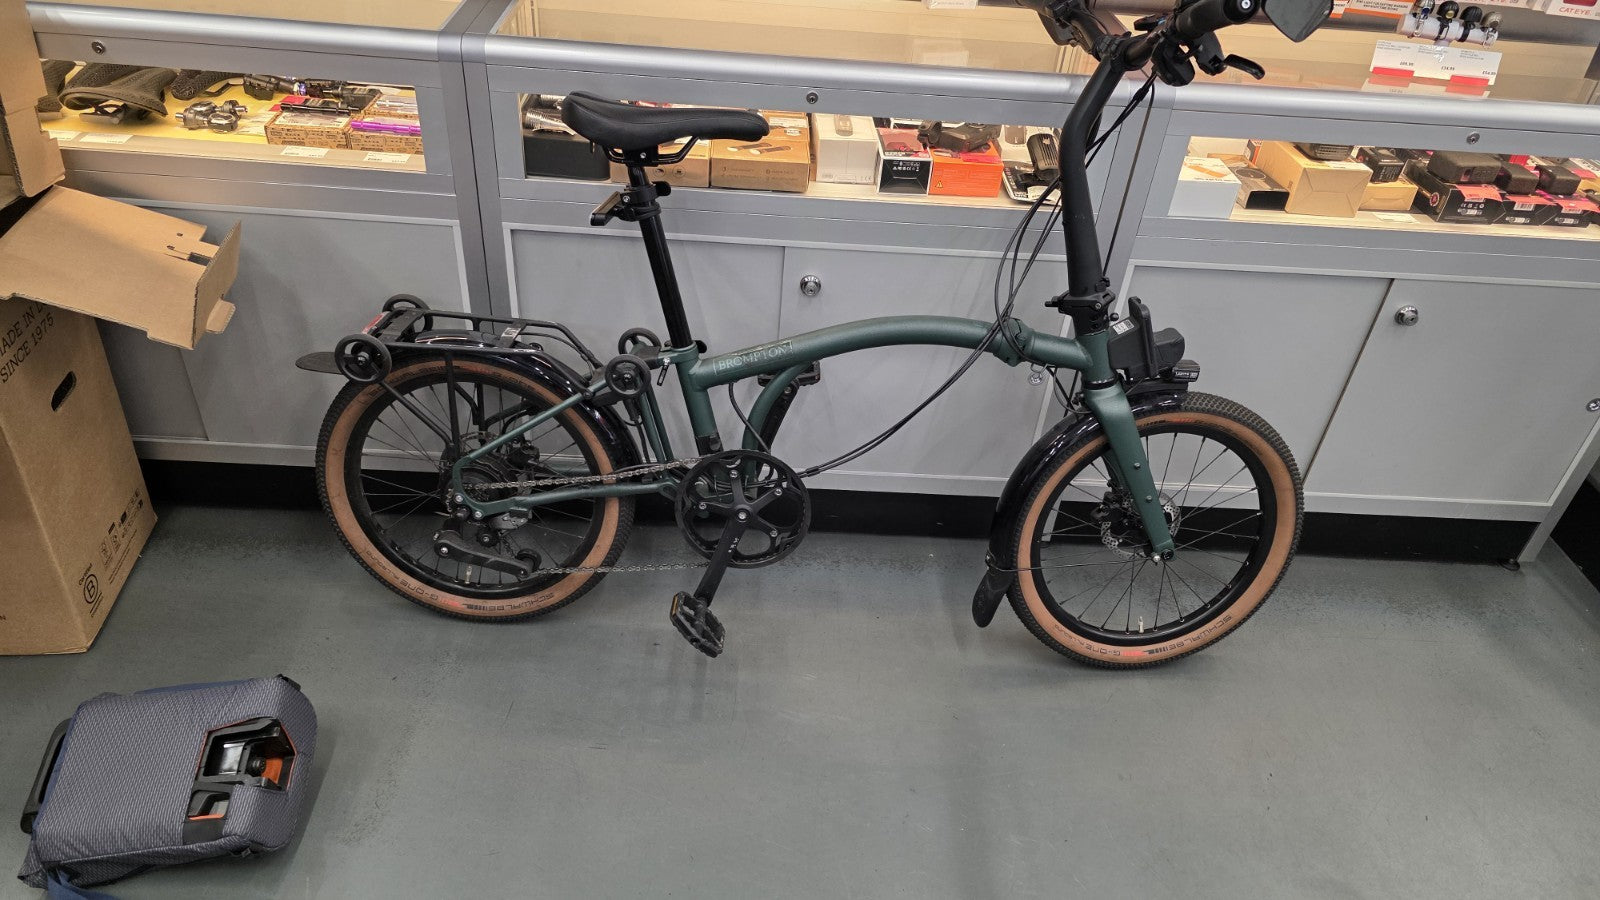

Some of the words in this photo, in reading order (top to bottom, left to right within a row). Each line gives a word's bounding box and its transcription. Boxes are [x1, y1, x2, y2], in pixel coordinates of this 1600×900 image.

[22, 306, 36, 328] IN
[0, 341, 31, 383] SINCE
[31, 312, 54, 346] 1975
[718, 345, 788, 370] BROMPTON
[400, 579, 439, 601] G-ONE
[488, 592, 554, 611] SCHWALBE
[1168, 615, 1232, 650] SCHWALBE
[1086, 644, 1121, 657] G-ONE
